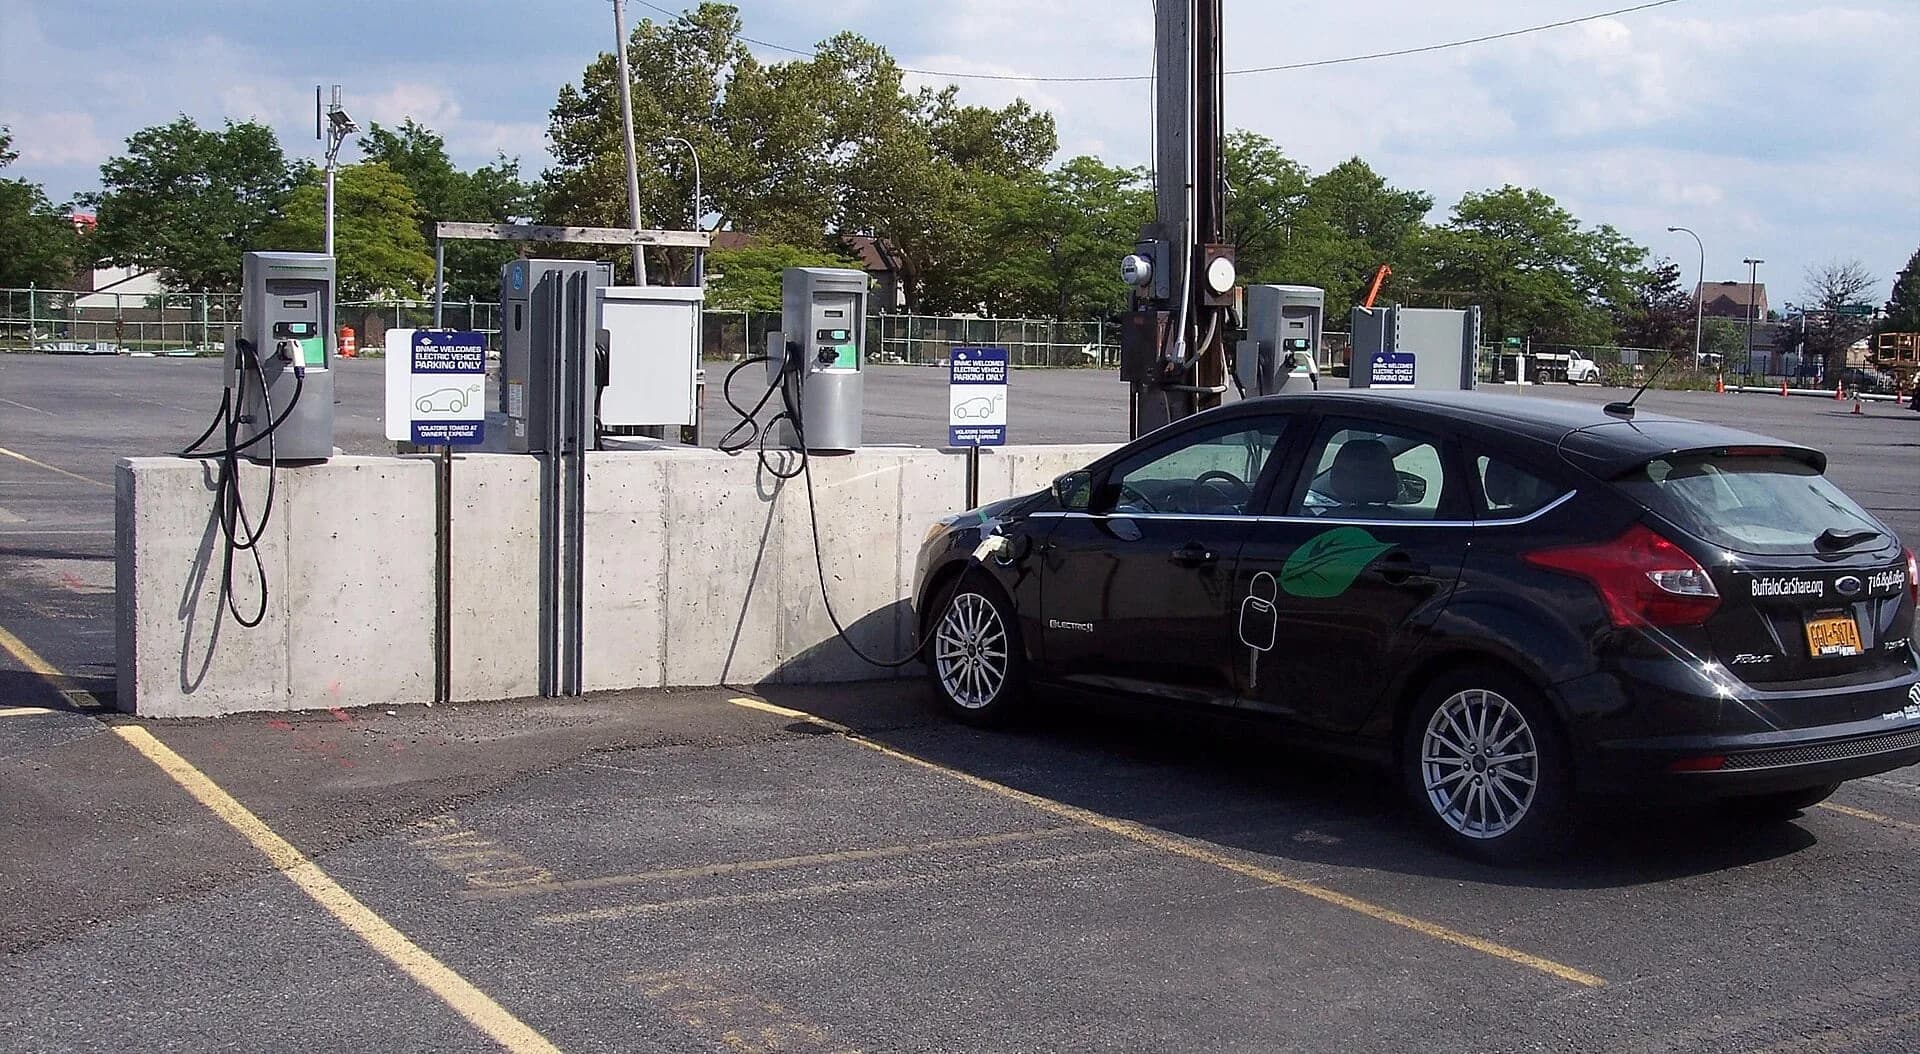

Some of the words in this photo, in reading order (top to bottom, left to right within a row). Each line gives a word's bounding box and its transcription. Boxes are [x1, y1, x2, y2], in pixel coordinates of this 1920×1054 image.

[415, 345, 439, 353] BNMC
[440, 345, 482, 353] WELCOMES
[415, 353, 450, 361] ELECTRIC
[451, 353, 482, 361] VEHICLE
[415, 361, 456, 370] PARKING
[457, 361, 482, 370] ONLY
[953, 373, 985, 381] PARKING
[985, 373, 1005, 381] ONLY
[1373, 374, 1398, 382] PARKING
[1398, 374, 1413, 382] ONLY
[1751, 576, 1824, 598] BuffaloCarShare.org
